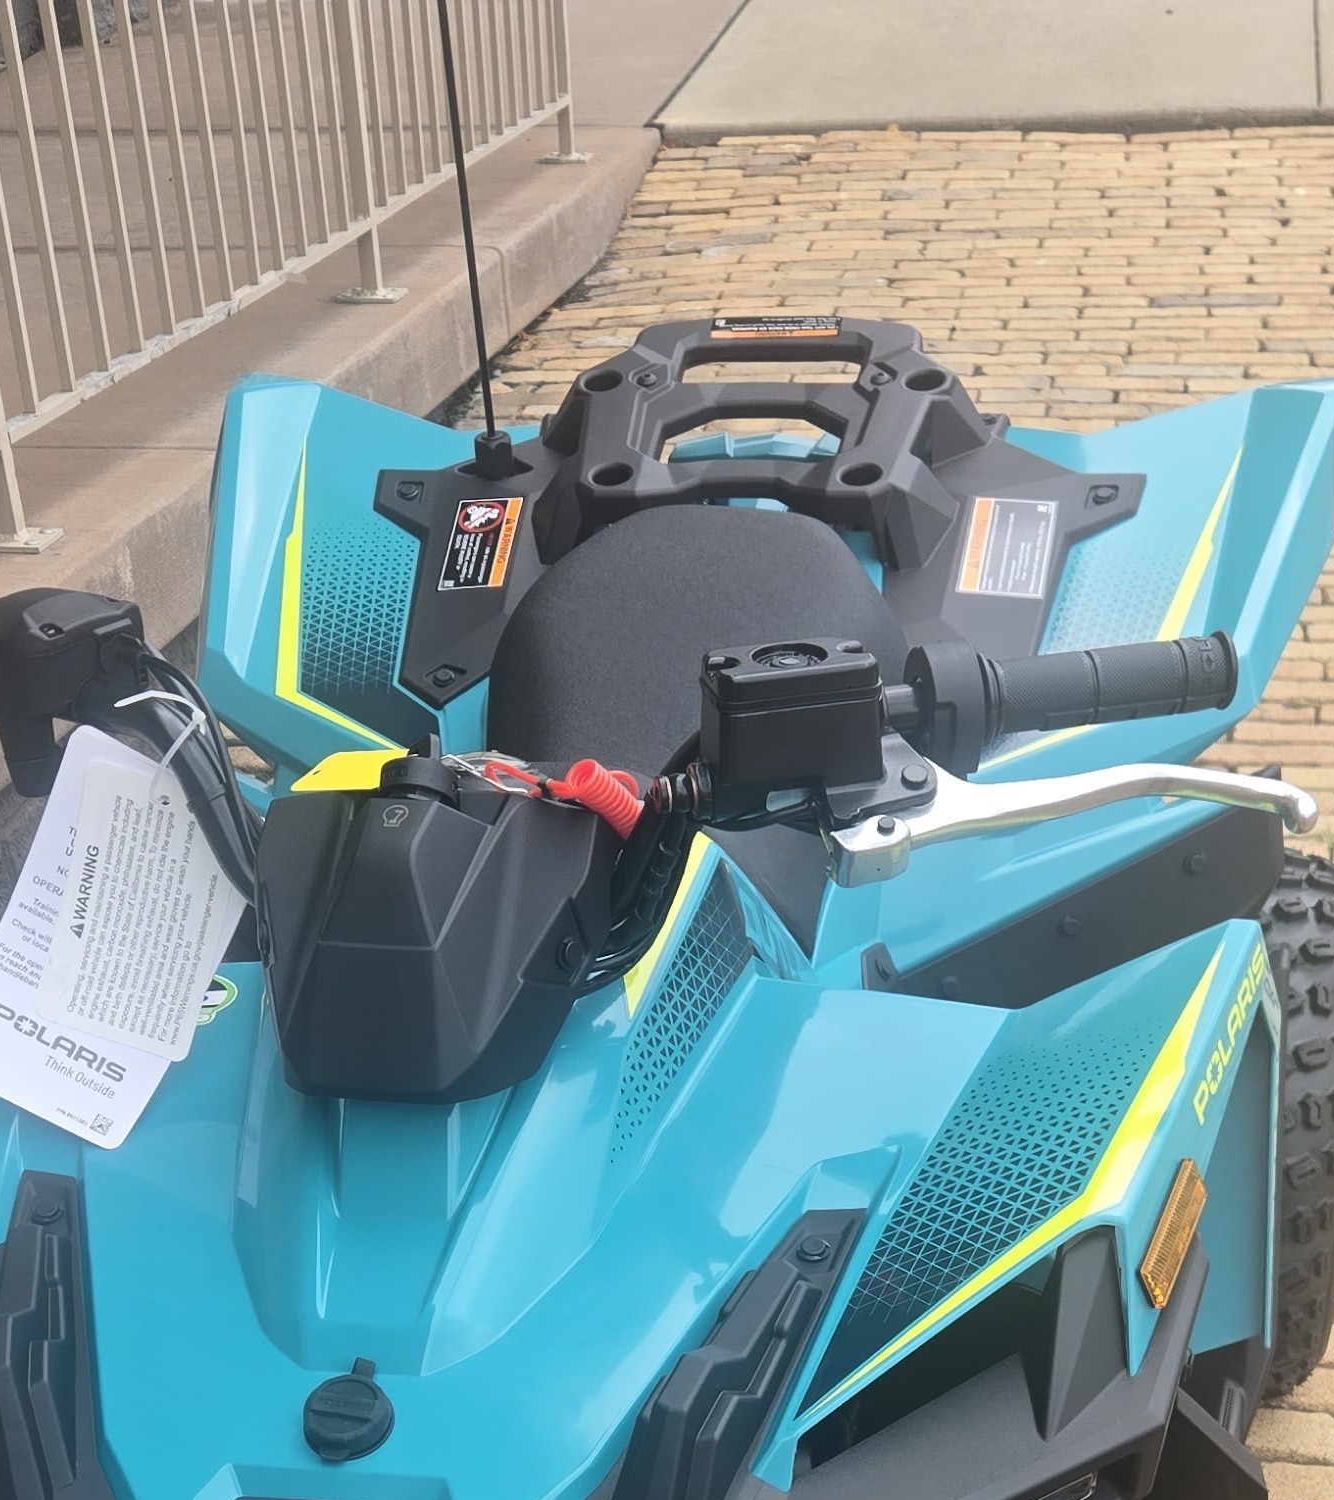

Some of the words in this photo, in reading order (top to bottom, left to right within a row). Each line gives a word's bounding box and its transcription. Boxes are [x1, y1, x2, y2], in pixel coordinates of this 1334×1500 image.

[497, 526, 513, 564] WARNING
[120, 799, 134, 833] including
[165, 812, 175, 838] engine
[140, 830, 149, 853] cause
[184, 821, 195, 844] hands
[113, 835, 126, 874] chemicals
[149, 845, 157, 855] To
[161, 840, 169, 852] the
[182, 846, 190, 864] your
[157, 854, 166, 868] idle
[73, 844, 100, 921] WARNING
[80, 936, 95, 971] servicing
[89, 919, 97, 935] and
[105, 824, 117, 865] passenger
[112, 795, 121, 822] vehicle
[111, 875, 118, 883] to
[178, 864, 187, 885] wash
[109, 885, 117, 899] you
[152, 883, 161, 894] do
[176, 887, 182, 895] or
[128, 901, 135, 911] of
[135, 880, 150, 929] reproductive
[169, 897, 180, 923] gloves
[88, 993, 101, 1019] engine
[106, 930, 117, 957] carbon
[113, 889, 128, 928] monoxide,
[131, 827, 139, 842] and
[102, 901, 113, 929] expose
[121, 912, 133, 933] State
[11, 918, 38, 937] Check
[165, 924, 174, 943] wear
[22, 935, 31, 943] or
[98, 931, 106, 946] can
[118, 934, 127, 947] the
[130, 930, 140, 950] other
[135, 930, 152, 967] breathing
[184, 941, 192, 949] to
[12, 950, 26, 962] the
[90, 947, 102, 975] vehicle
[128, 952, 134, 961] or
[129, 1007, 143, 1032] except
[138, 996, 145, 1005] as
[152, 923, 163, 951] service
[159, 904, 167, 922] your
[163, 875, 173, 902] vehicle
[161, 945, 169, 960] and
[182, 951, 190, 961] go
[5, 957, 28, 973] reach
[108, 958, 121, 984] known
[156, 962, 165, 980] area
[117, 962, 132, 991] defects
[131, 968, 141, 990] avoid
[147, 1001, 167, 1039] frequently
[161, 978, 172, 999] when
[167, 942, 183, 976] servicing
[177, 923, 185, 941] your
[168, 962, 187, 1006] information
[81, 975, 95, 1006] off-road
[106, 985, 114, 998] are
[112, 992, 123, 1009] birth
[78, 1007, 85, 1016] or
[98, 1000, 110, 1023] which
[109, 1011, 118, 1026] and
[163, 1007, 174, 1027] more
[157, 1029, 167, 1042] For
[1193, 943, 1267, 1126] POLARIS
[43, 1055, 76, 1079] Think
[74, 1071, 117, 1100] Outside
